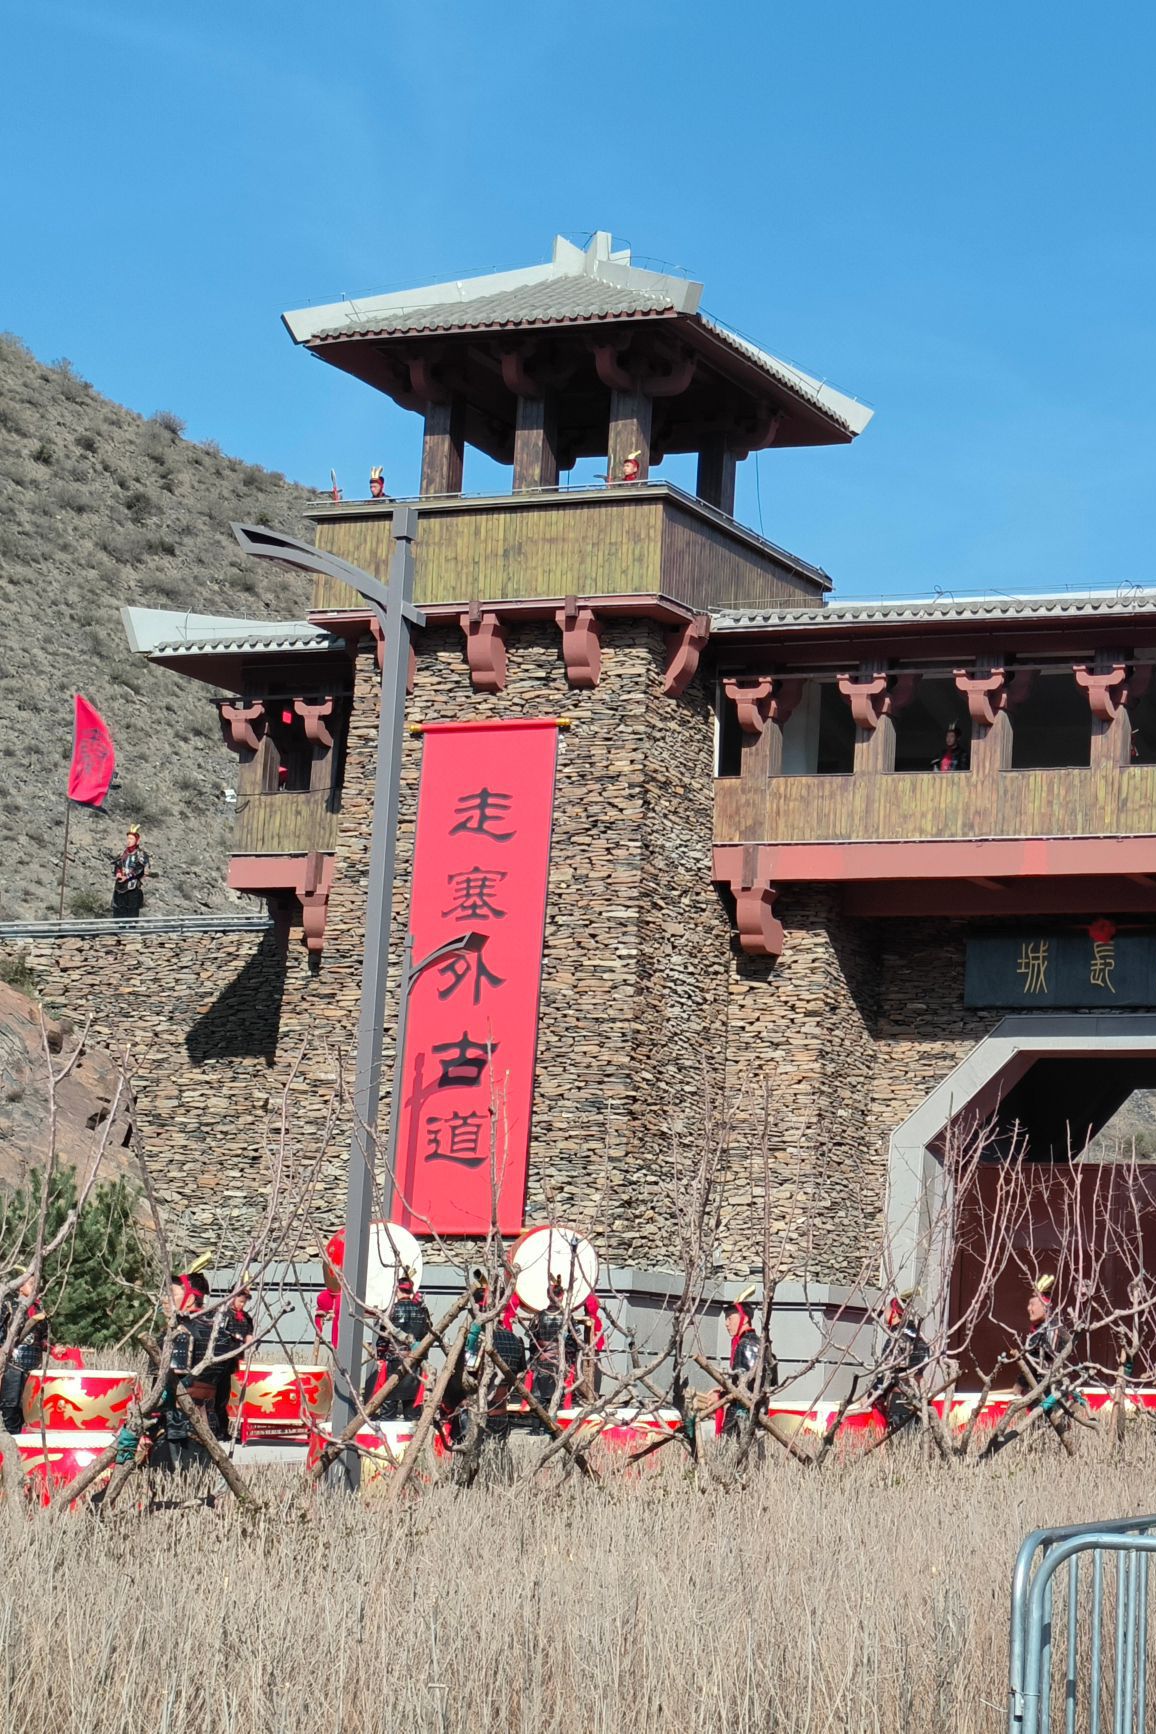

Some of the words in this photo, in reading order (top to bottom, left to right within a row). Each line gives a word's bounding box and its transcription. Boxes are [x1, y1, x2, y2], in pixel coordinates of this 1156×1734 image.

[424, 786, 518, 1170] 走塞外古道
